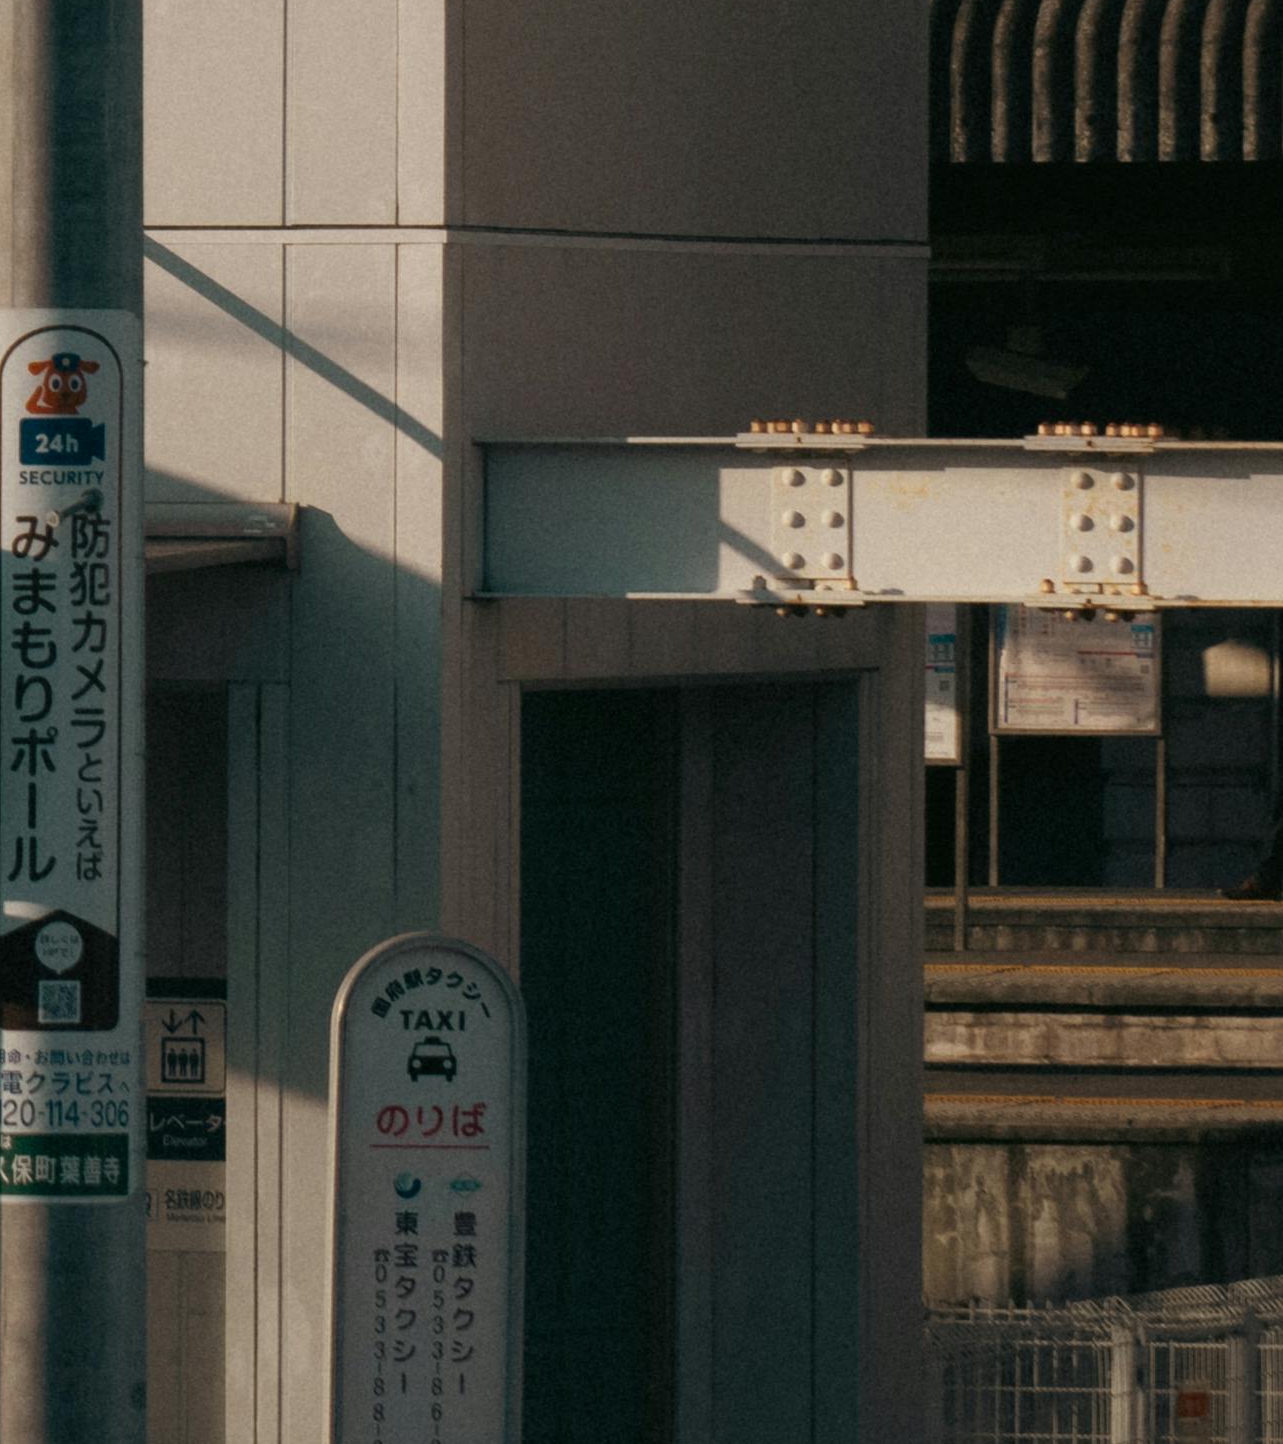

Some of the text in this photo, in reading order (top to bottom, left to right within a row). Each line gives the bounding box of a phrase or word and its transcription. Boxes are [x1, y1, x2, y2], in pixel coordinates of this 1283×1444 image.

[35, 432, 79, 454] 24h
[19, 470, 105, 486] SECURITY
[8, 515, 60, 883] みまもりポール
[70, 513, 110, 881] 防犯カメラといえば
[399, 1010, 465, 1031] TAXI
[148, 1113, 225, 1132] レベータ
[376, 1102, 487, 1138] のりば
[392, 1209, 420, 1395] 東宝タクシー
[450, 1210, 478, 1395] 豊鉄タクシー
